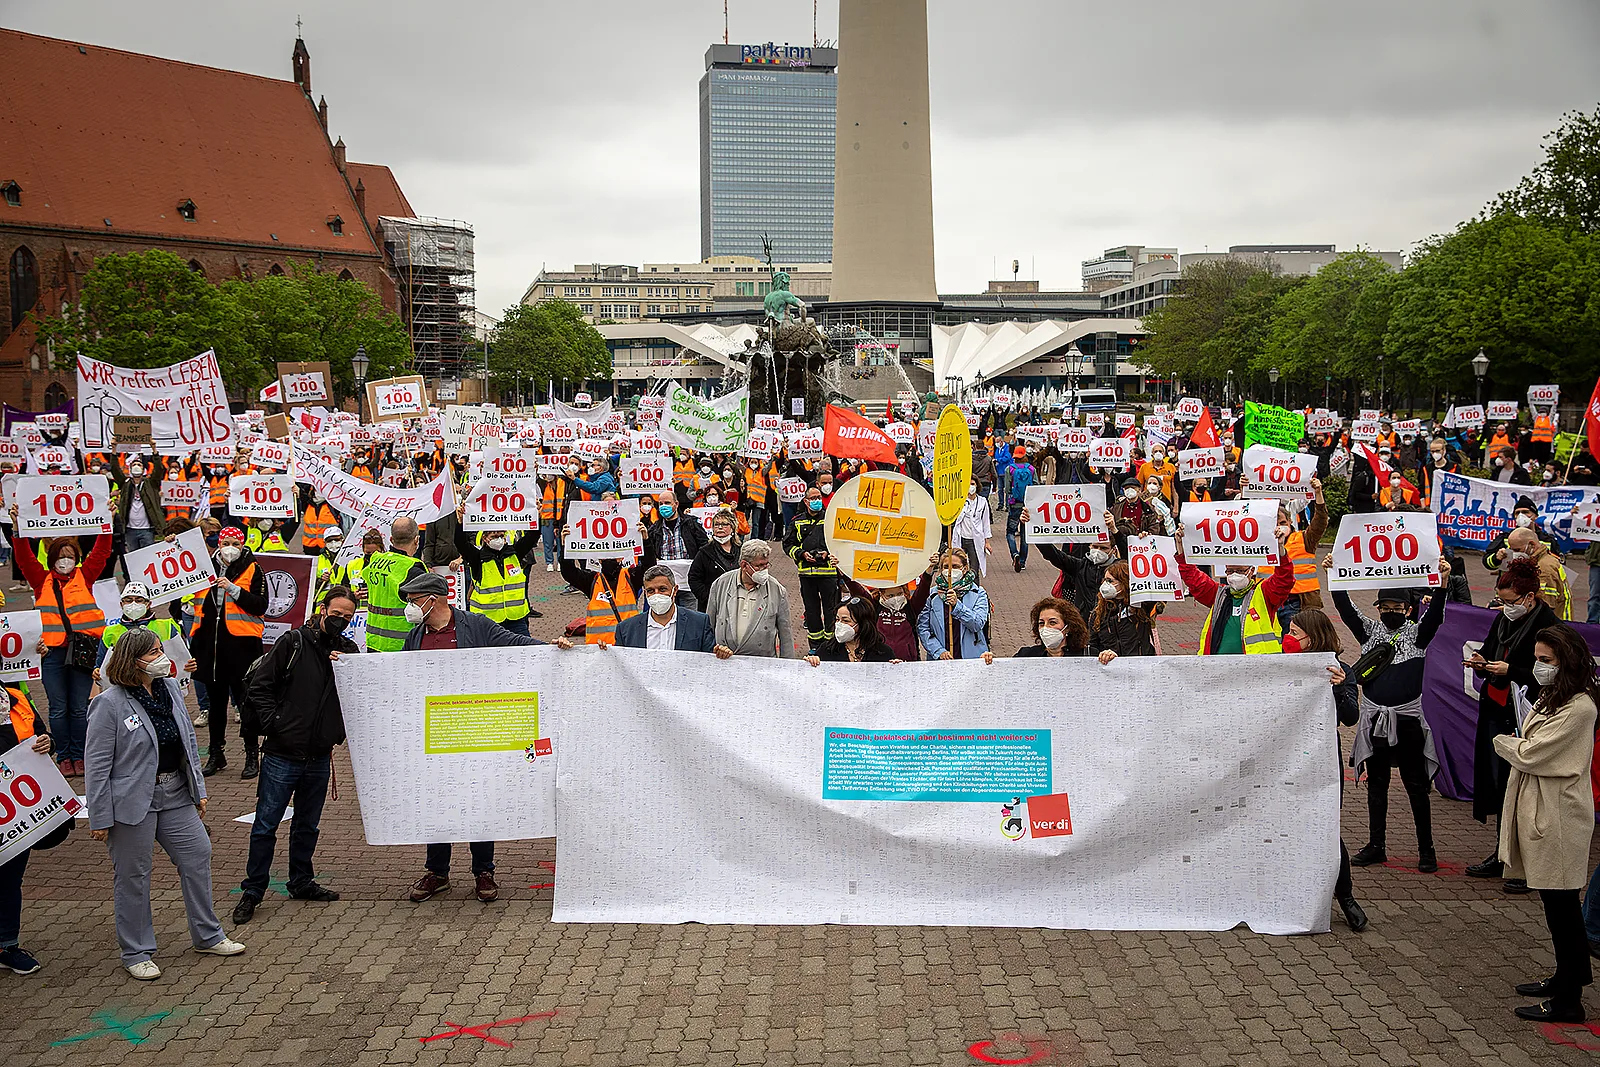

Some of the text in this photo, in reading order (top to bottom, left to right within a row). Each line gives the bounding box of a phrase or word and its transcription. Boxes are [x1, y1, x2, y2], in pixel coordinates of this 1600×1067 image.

[742, 42, 811, 61] park inn
[78, 354, 219, 388] WIR retten LEBEN
[290, 381, 318, 392] 100
[137, 381, 218, 412] wer rettet
[384, 392, 412, 404] 100
[1179, 404, 1198, 414] 100
[481, 412, 498, 426] Job
[1459, 412, 1480, 420] 100
[176, 406, 230, 446] UNS
[604, 422, 620, 431] 100
[668, 418, 708, 436] Für mehr
[1313, 418, 1333, 427] 100
[1397, 421, 1414, 429] 100
[349, 432, 370, 440] 100
[450, 424, 500, 438] will KEINER
[549, 428, 572, 438] 100
[838, 426, 855, 438] DIE
[891, 427, 910, 436] 100
[1356, 426, 1376, 434] 100
[636, 439, 662, 449] 100
[695, 433, 743, 452] Personal
[794, 439, 820, 450] 100
[1064, 434, 1086, 443] 100
[206, 446, 230, 456] 100
[578, 442, 602, 453] 100
[1096, 446, 1123, 457] 100
[40, 453, 62, 462] 100
[258, 448, 282, 460] 100
[544, 455, 568, 465] 100
[492, 458, 527, 472] 100
[1186, 457, 1216, 468] 100
[629, 468, 664, 482] 100
[1253, 465, 1301, 484] 100
[50, 484, 74, 492] Tage
[168, 488, 194, 498] 100
[782, 484, 806, 496] 100
[1266, 484, 1284, 492] Zeit
[1455, 484, 1467, 492] alle
[240, 487, 282, 504] 100
[859, 482, 903, 511] ALLE
[33, 492, 94, 516] 100
[373, 494, 415, 510] LEBT
[475, 494, 525, 512] 100
[488, 514, 508, 522] Zeit
[510, 514, 532, 522] läuft
[1037, 502, 1091, 524] 100
[1215, 509, 1240, 517] Tage
[27, 516, 104, 528] Die Zeit läuft
[838, 517, 878, 535] WOLLEN
[1438, 514, 1505, 528] Ihr seid für
[576, 518, 628, 539] 100
[1033, 525, 1100, 534] Die Zeit läuft
[1196, 518, 1259, 543] 100
[1364, 524, 1393, 533] Tage
[1439, 528, 1486, 540] wir sind
[570, 540, 636, 550] Die Zeit läuft
[1192, 544, 1270, 555] Die Zeit läuft
[1344, 533, 1419, 564] 100
[156, 546, 176, 558] Tage
[144, 550, 197, 585] 100
[858, 556, 894, 573] SEIN
[1131, 554, 1168, 578] 00
[1338, 564, 1432, 578] Die Zeit läuft
[162, 578, 185, 593] Zeit
[186, 569, 210, 584] läuft
[1131, 580, 1176, 591] Zeit läuft
[830, 732, 872, 742] Gebraucht,
[874, 734, 916, 742] beklatscht,
[0, 774, 42, 826] 00
[30, 794, 66, 821] läuft
[1032, 820, 1068, 831] ver.di
